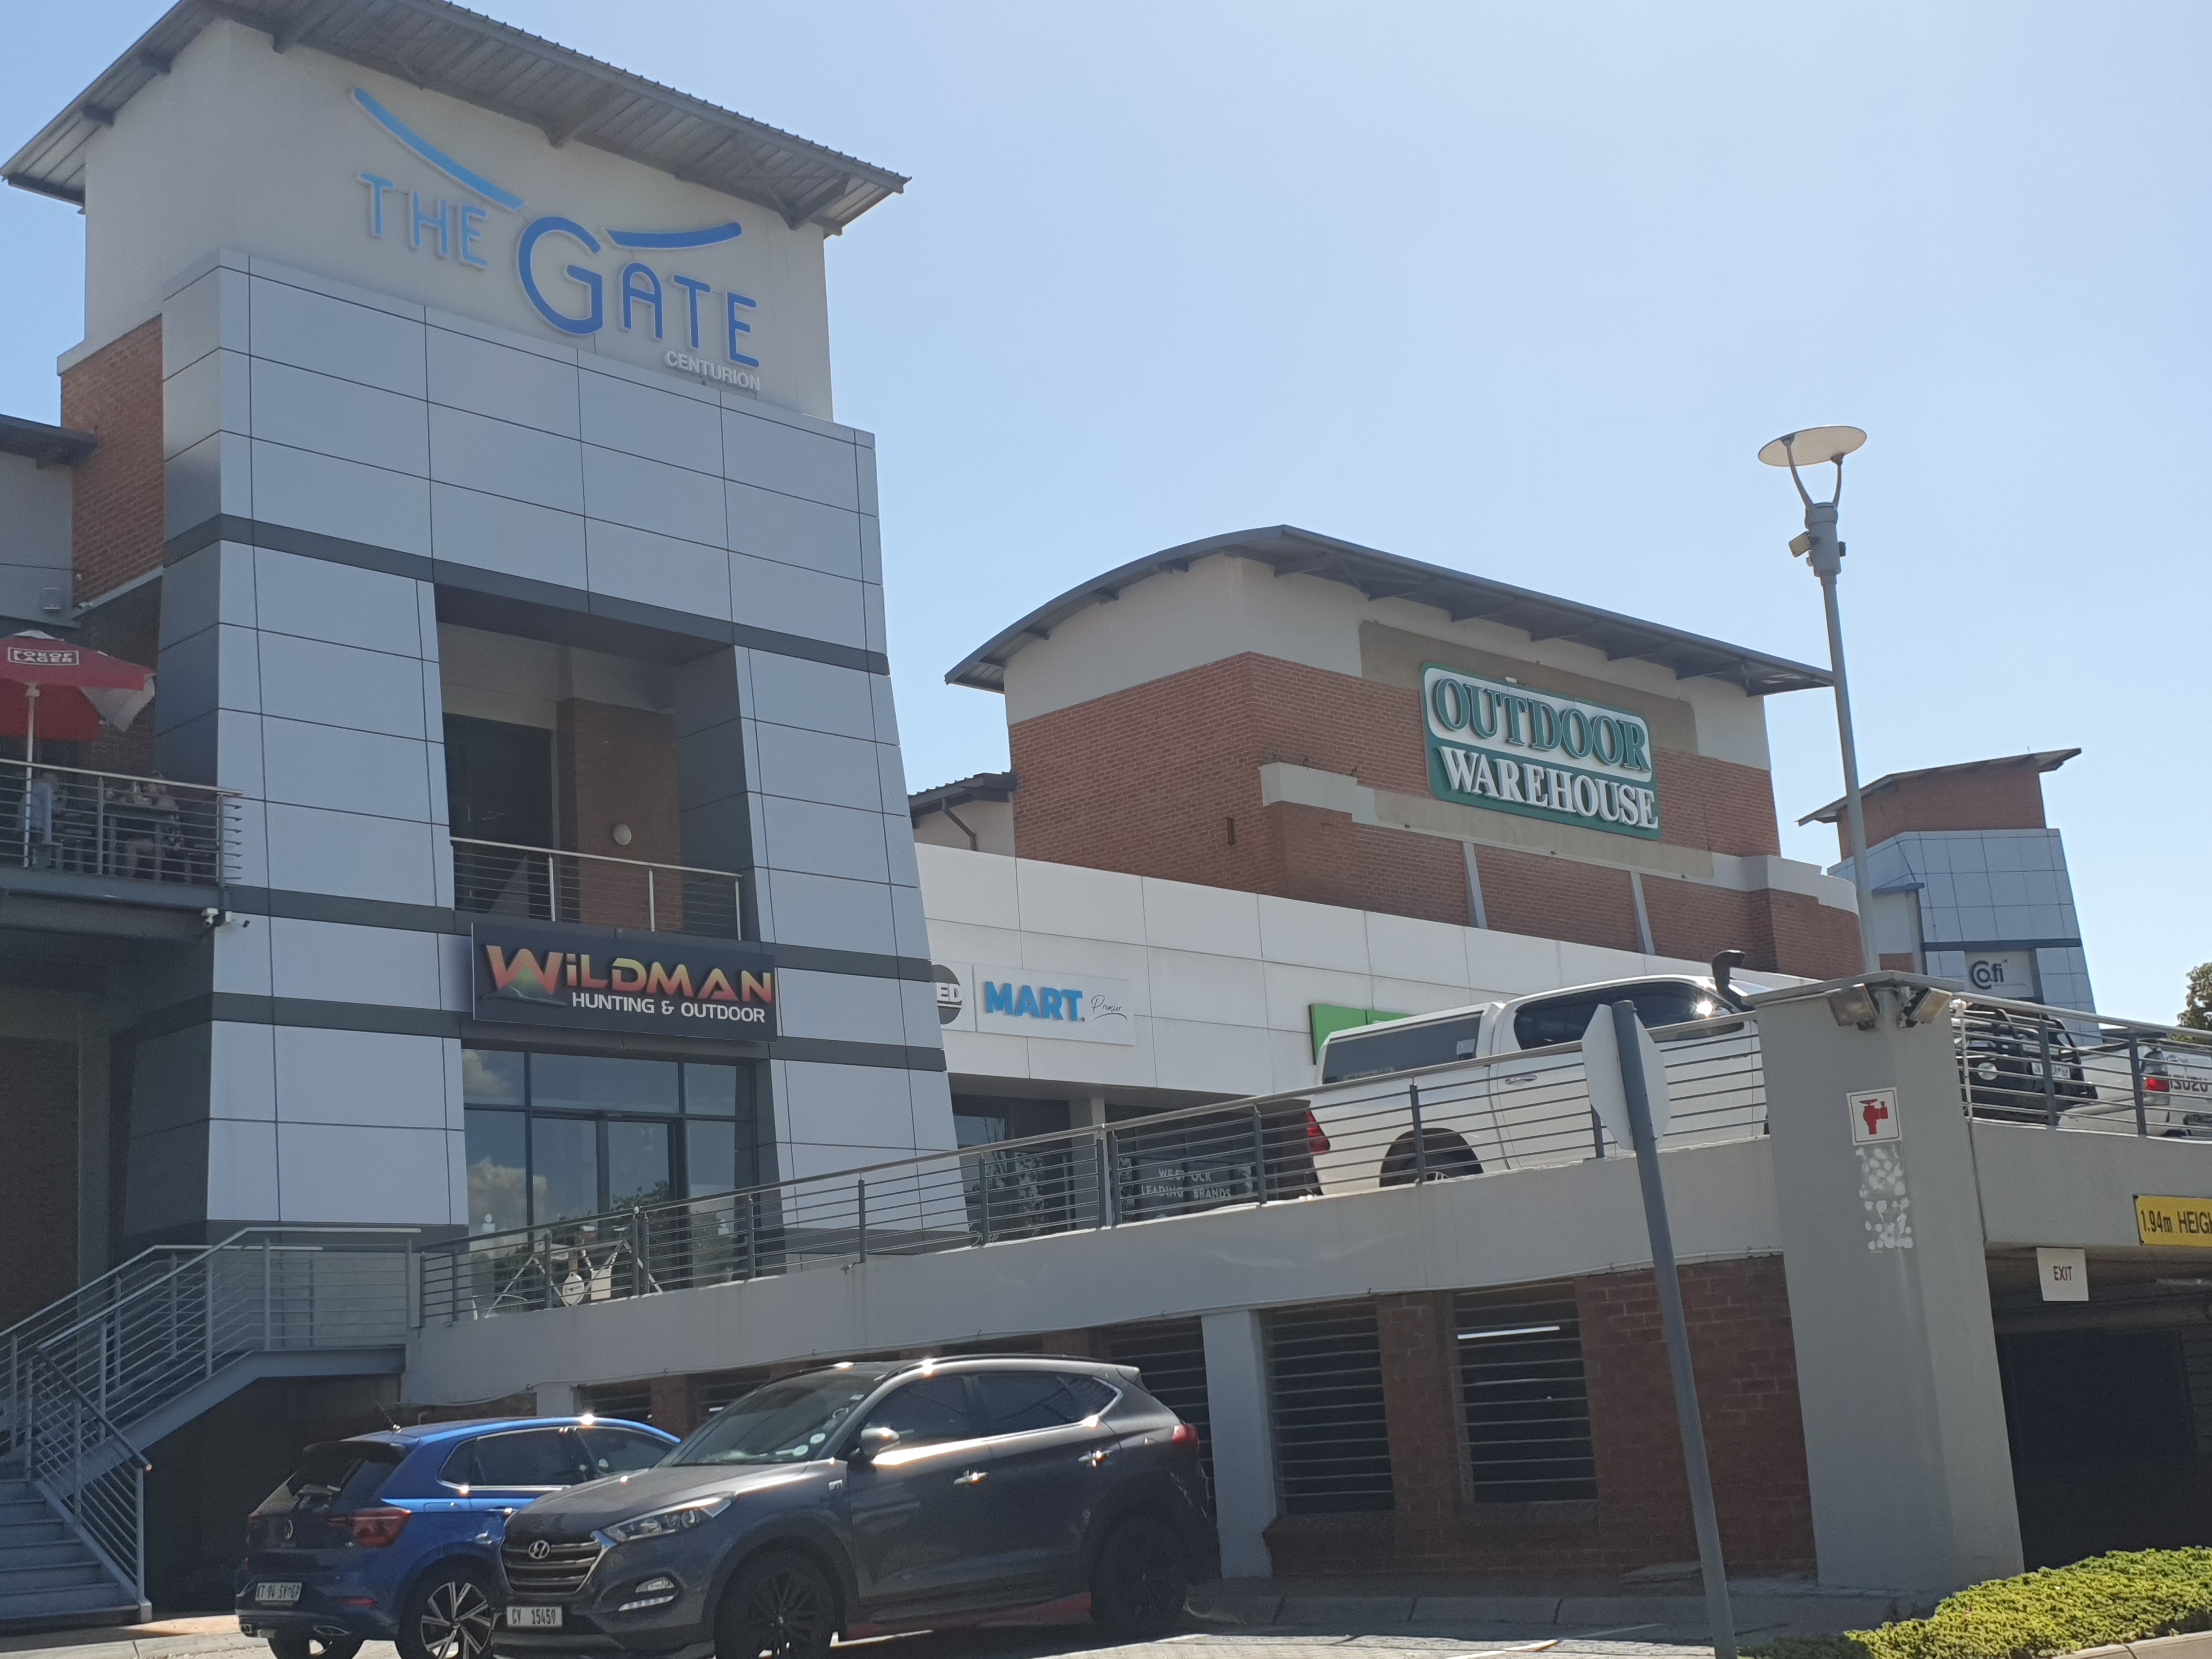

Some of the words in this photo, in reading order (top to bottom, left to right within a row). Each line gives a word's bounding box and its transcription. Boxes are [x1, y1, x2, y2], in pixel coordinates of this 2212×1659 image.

[359, 172, 488, 267] THE
[518, 216, 760, 368] GATE
[664, 350, 760, 391] CENTURION
[1435, 678, 1652, 773] OUTDOOR
[1438, 746, 1658, 830] WAREHOUSE
[572, 992, 654, 1014] HUNTING
[662, 1000, 674, 1015] &
[681, 1002, 765, 1023] OUTDOOR
[1091, 994, 1122, 1014] Premier
[2170, 1074, 2208, 1092] ISUZU
[1141, 1185, 1184, 1198] LEADING
[1193, 1188, 1231, 1199] BRANDS
[2141, 1210, 2173, 1233] 1.94m
[2053, 1266, 2072, 1281] EXIT
[531, 1609, 556, 1624] 15459
